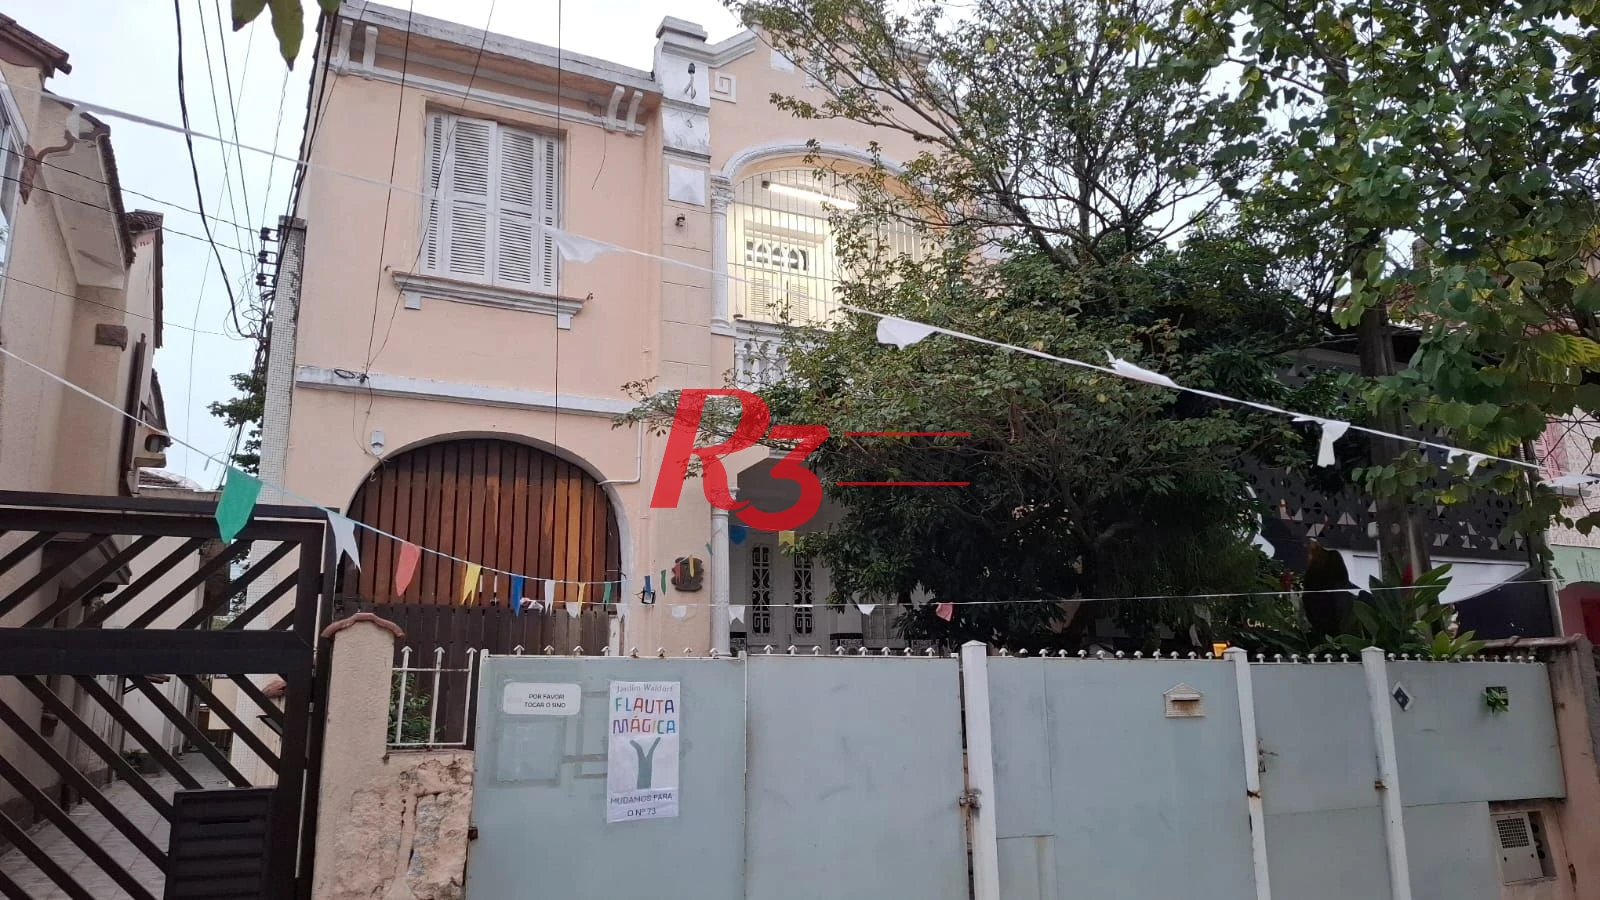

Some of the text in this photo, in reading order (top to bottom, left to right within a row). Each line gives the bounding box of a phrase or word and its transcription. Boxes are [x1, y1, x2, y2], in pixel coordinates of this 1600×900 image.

[615, 697, 675, 714] FLAUTA
[613, 715, 676, 734] MÁGICA
[610, 792, 673, 804] MUDAMOS PARA
[627, 809, 634, 817] O
[647, 807, 657, 815] 73
